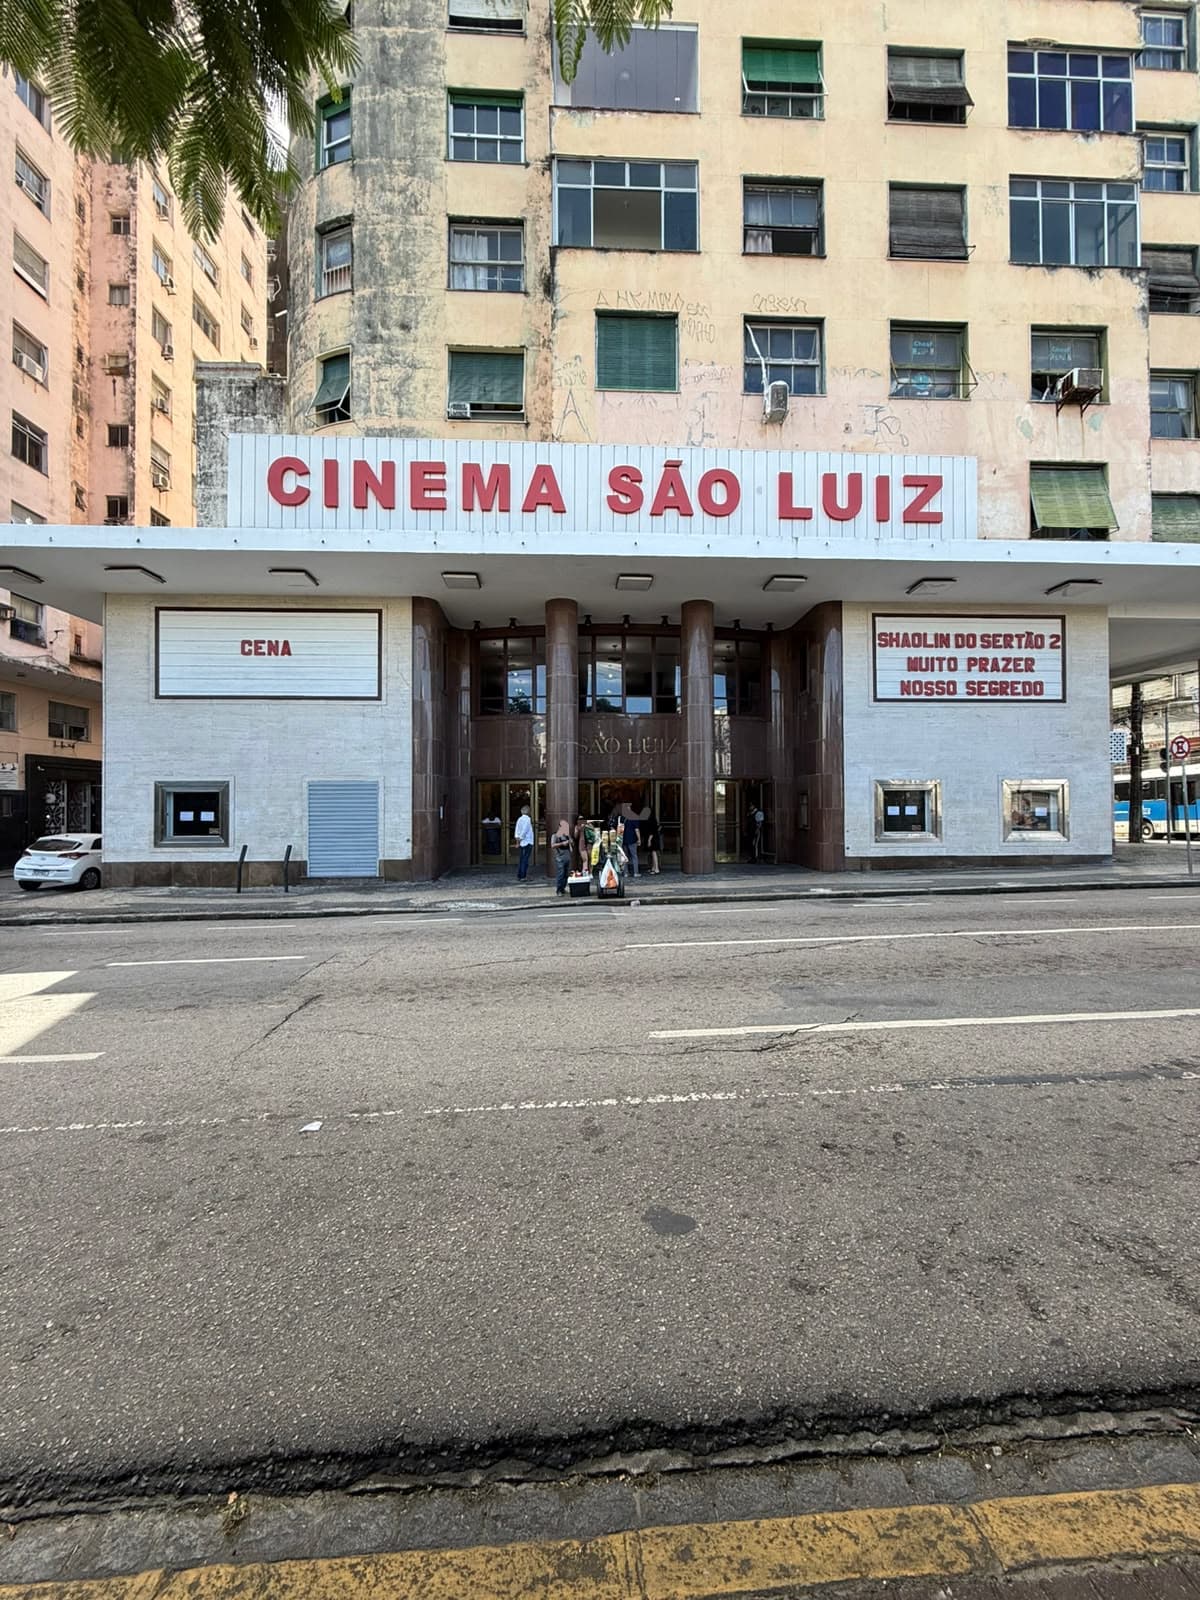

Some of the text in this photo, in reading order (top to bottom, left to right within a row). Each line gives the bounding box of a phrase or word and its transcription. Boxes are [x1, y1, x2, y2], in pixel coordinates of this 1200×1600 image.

[267, 457, 943, 523] CINEMA SÃO LUIZ
[240, 639, 292, 656] CENA
[878, 631, 1061, 649] SHAOLIN DO SERTÃO 2
[907, 656, 1036, 673] MUITO PRAZER
[900, 680, 1045, 697] NOSSO SEGREDO
